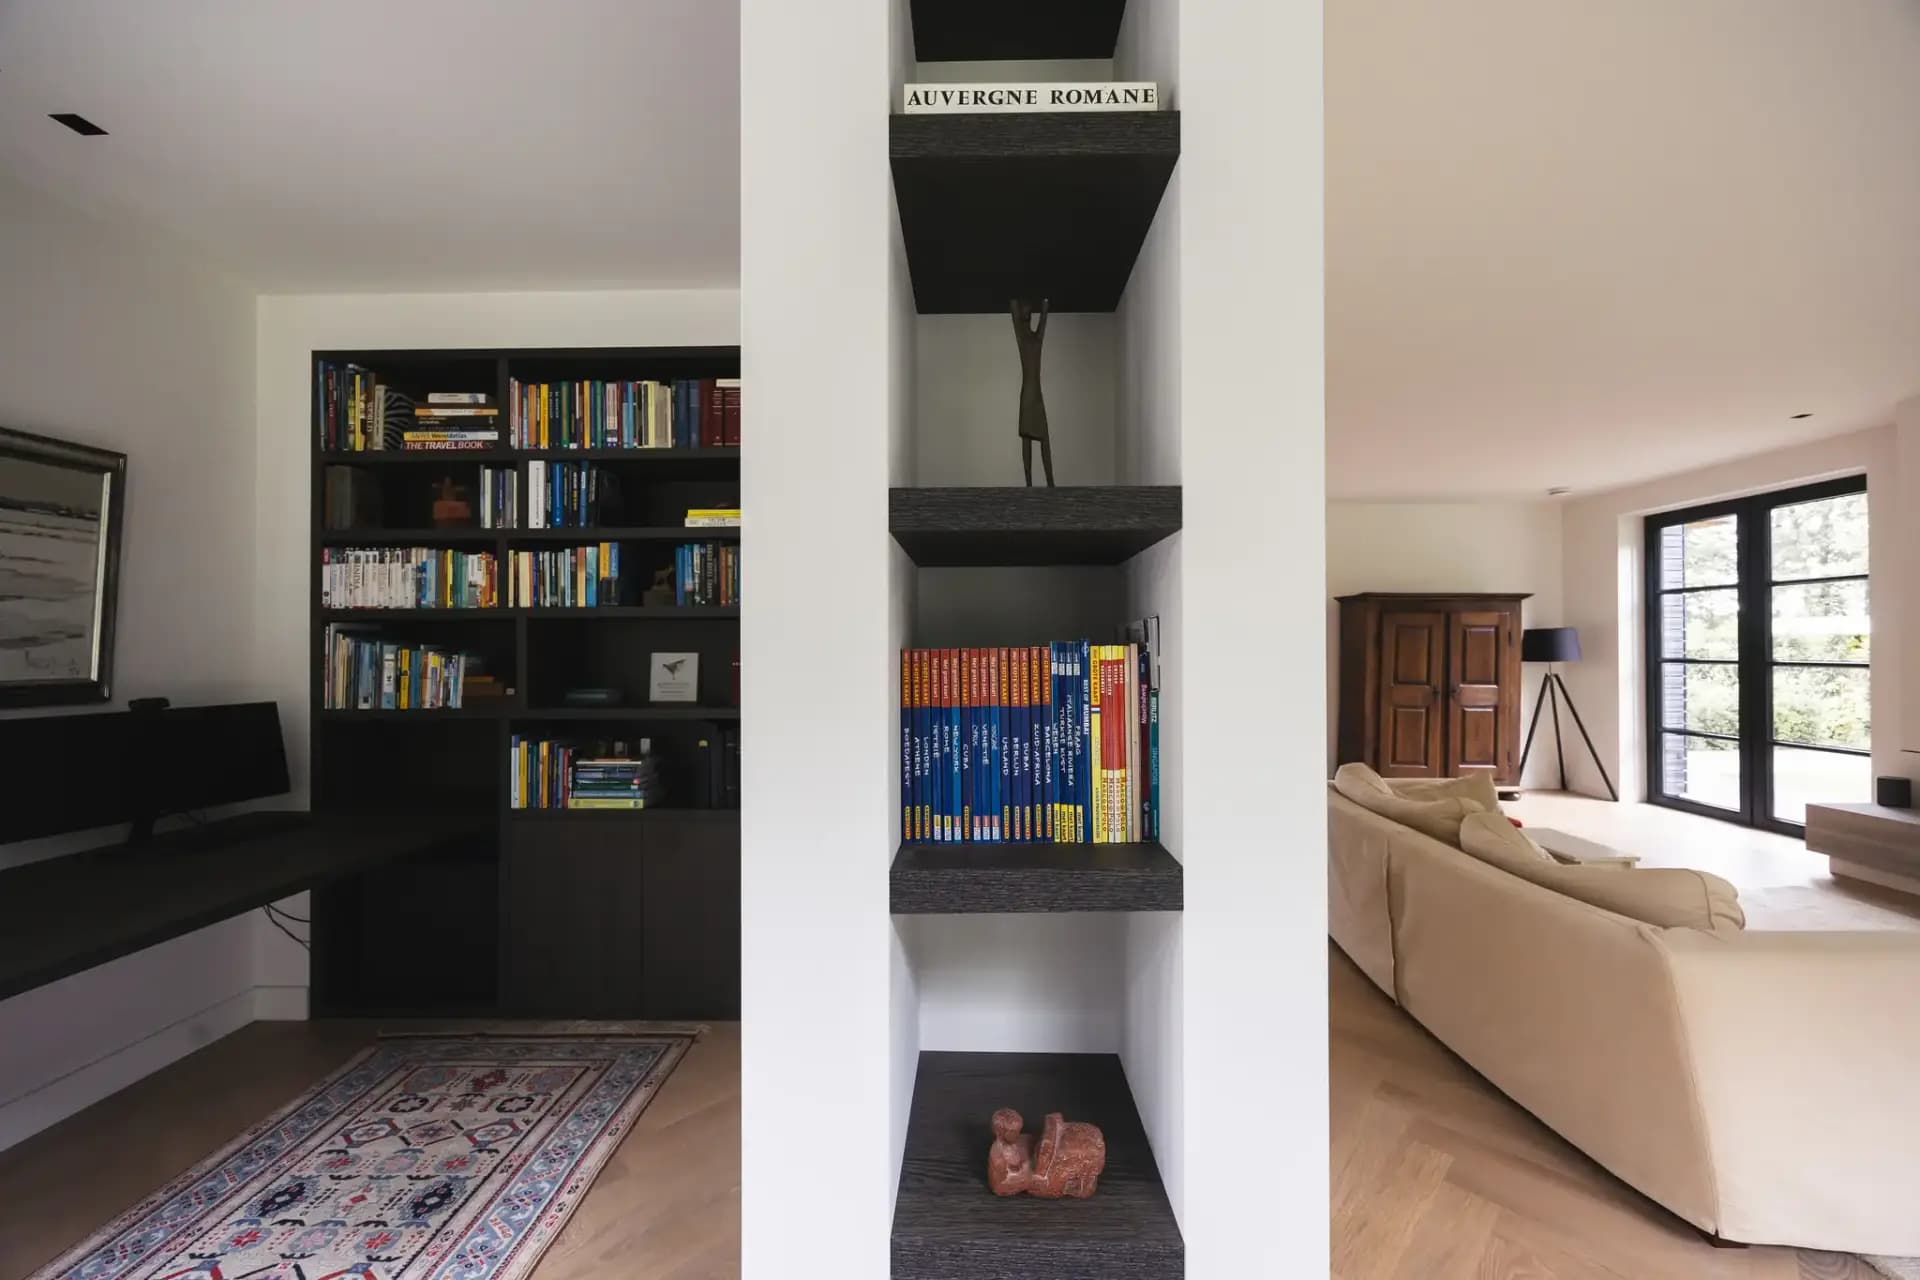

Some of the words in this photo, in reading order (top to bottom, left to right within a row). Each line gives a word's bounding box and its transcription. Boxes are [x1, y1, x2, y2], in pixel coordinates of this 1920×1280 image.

[907, 89, 1038, 106] AUVERGNE
[1050, 88, 1155, 104] ROMANE
[407, 441, 425, 450] THE
[425, 441, 458, 450] TRAVEL
[458, 441, 484, 450] BOOK
[353, 564, 361, 591] INDIA
